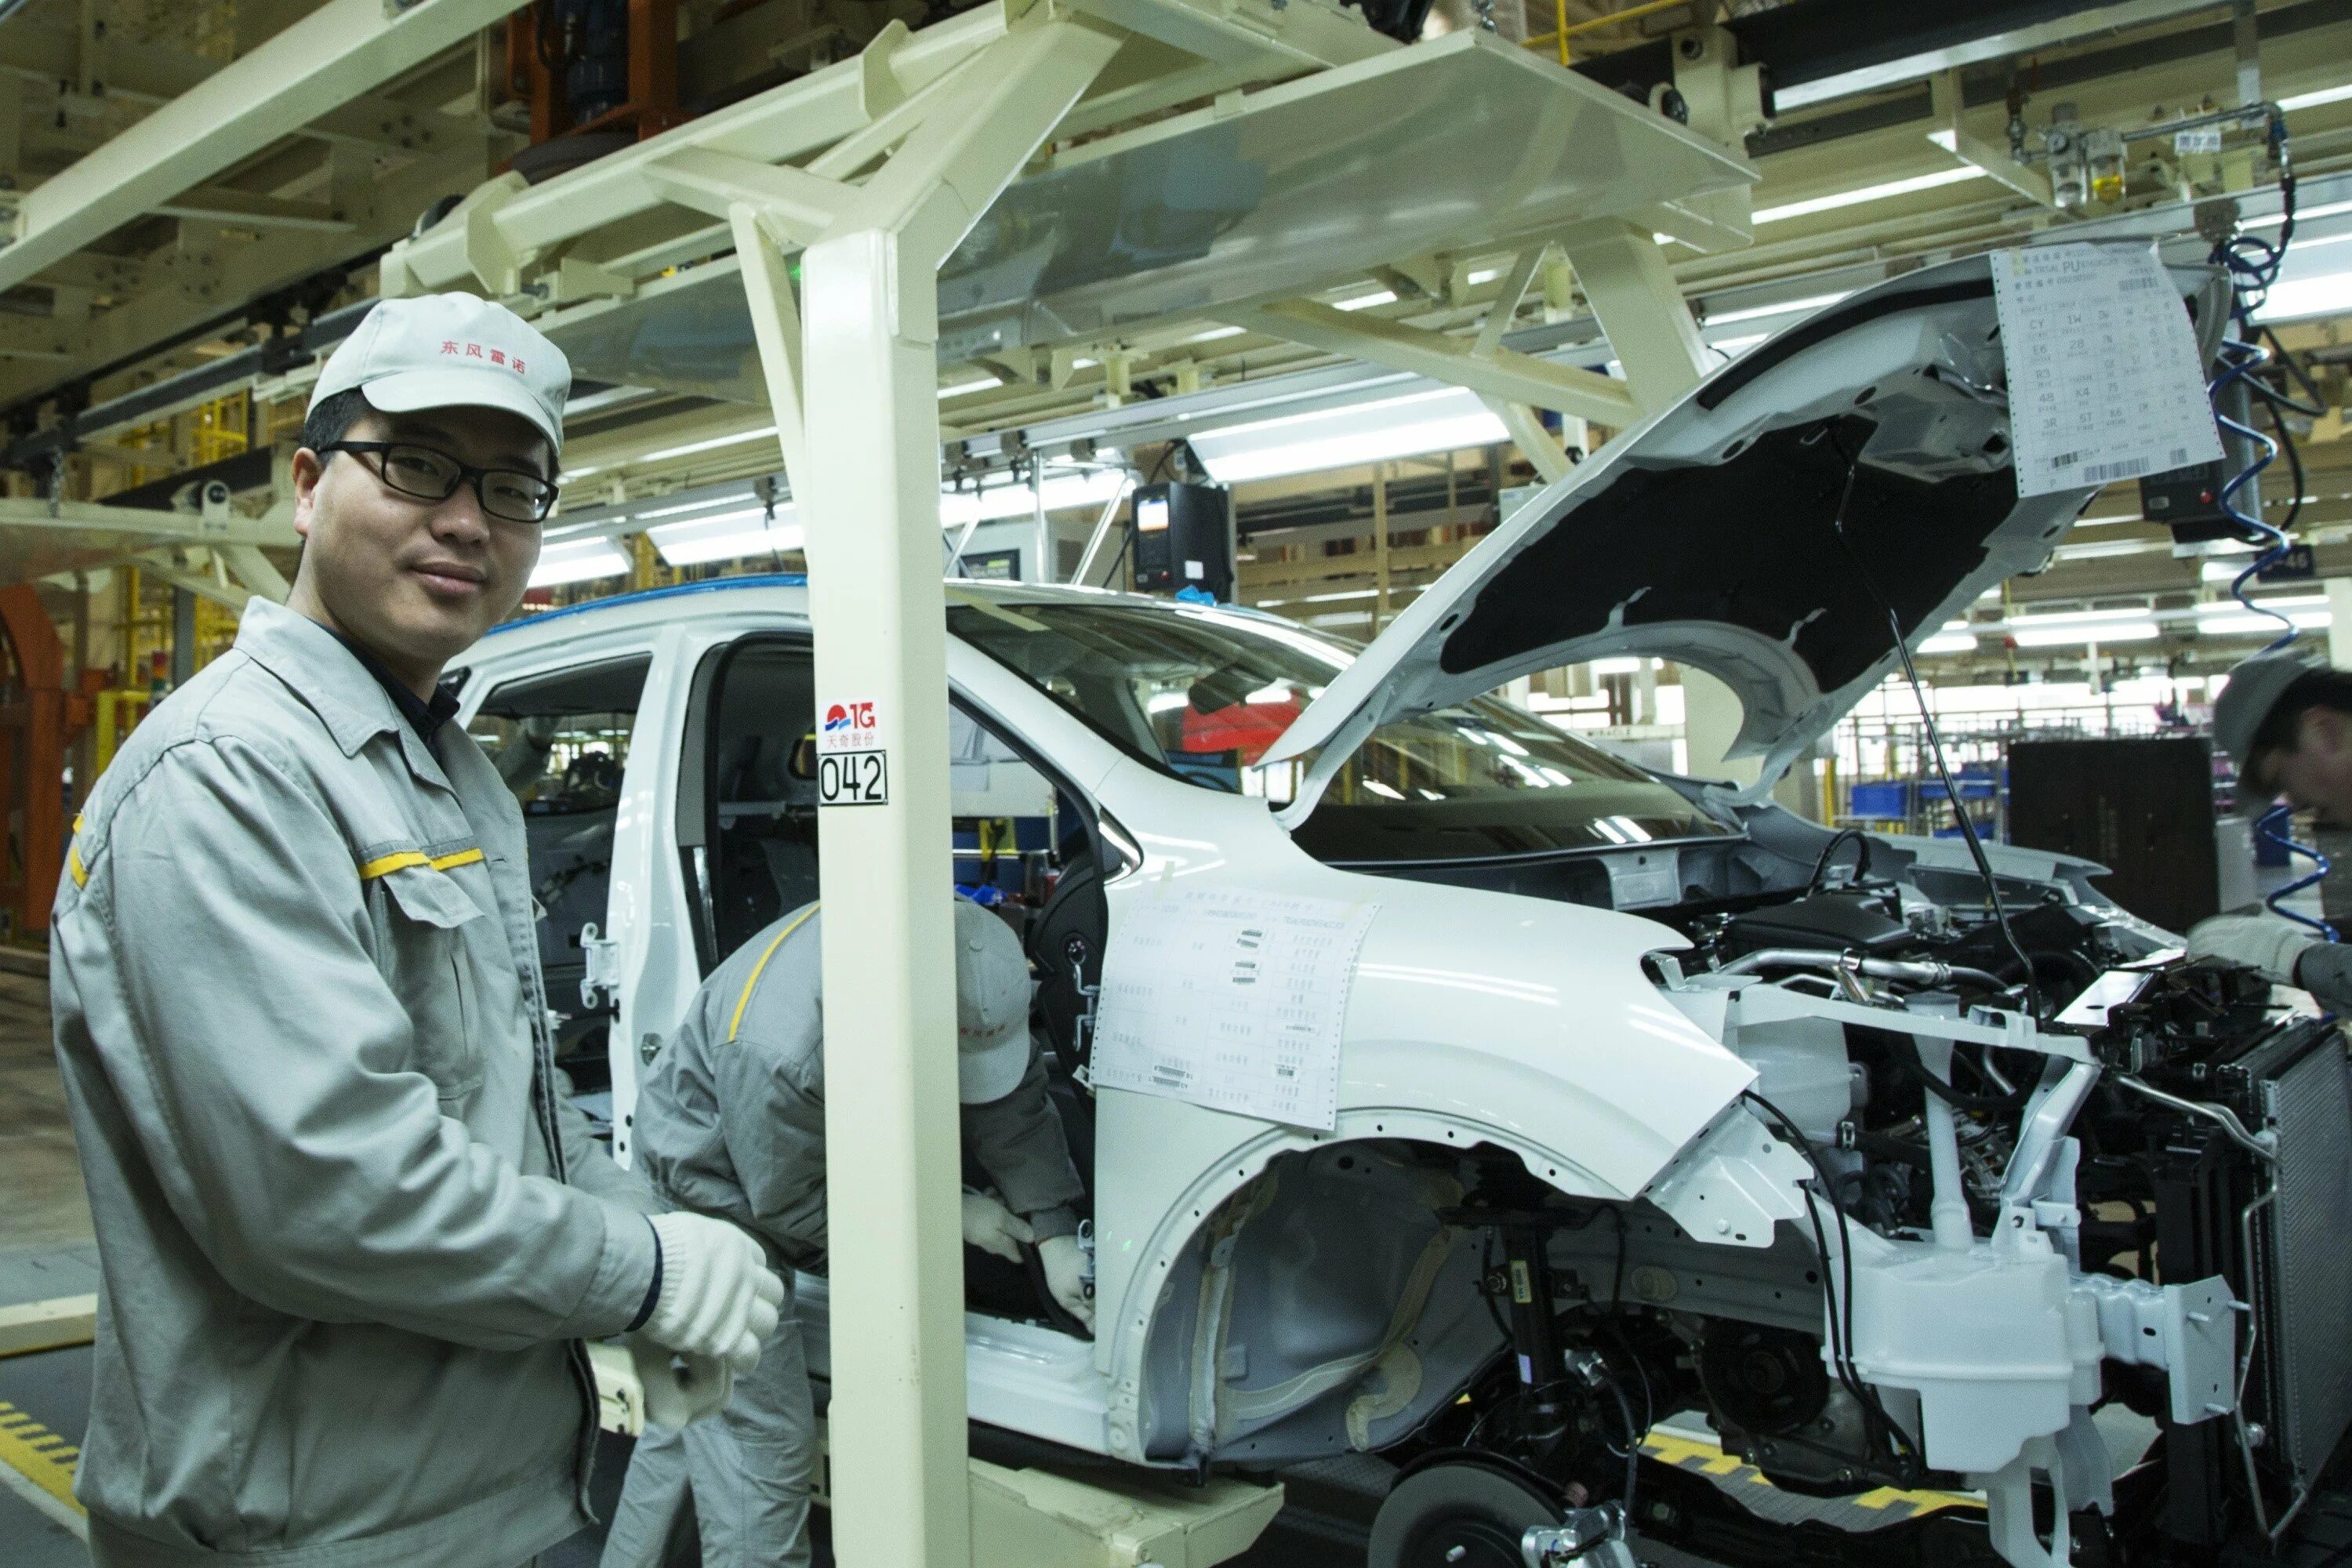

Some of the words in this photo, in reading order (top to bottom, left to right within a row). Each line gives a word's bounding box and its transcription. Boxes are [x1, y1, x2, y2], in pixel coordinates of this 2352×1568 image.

[440, 340, 527, 375] 东风雷诺
[821, 755, 881, 801] 042
